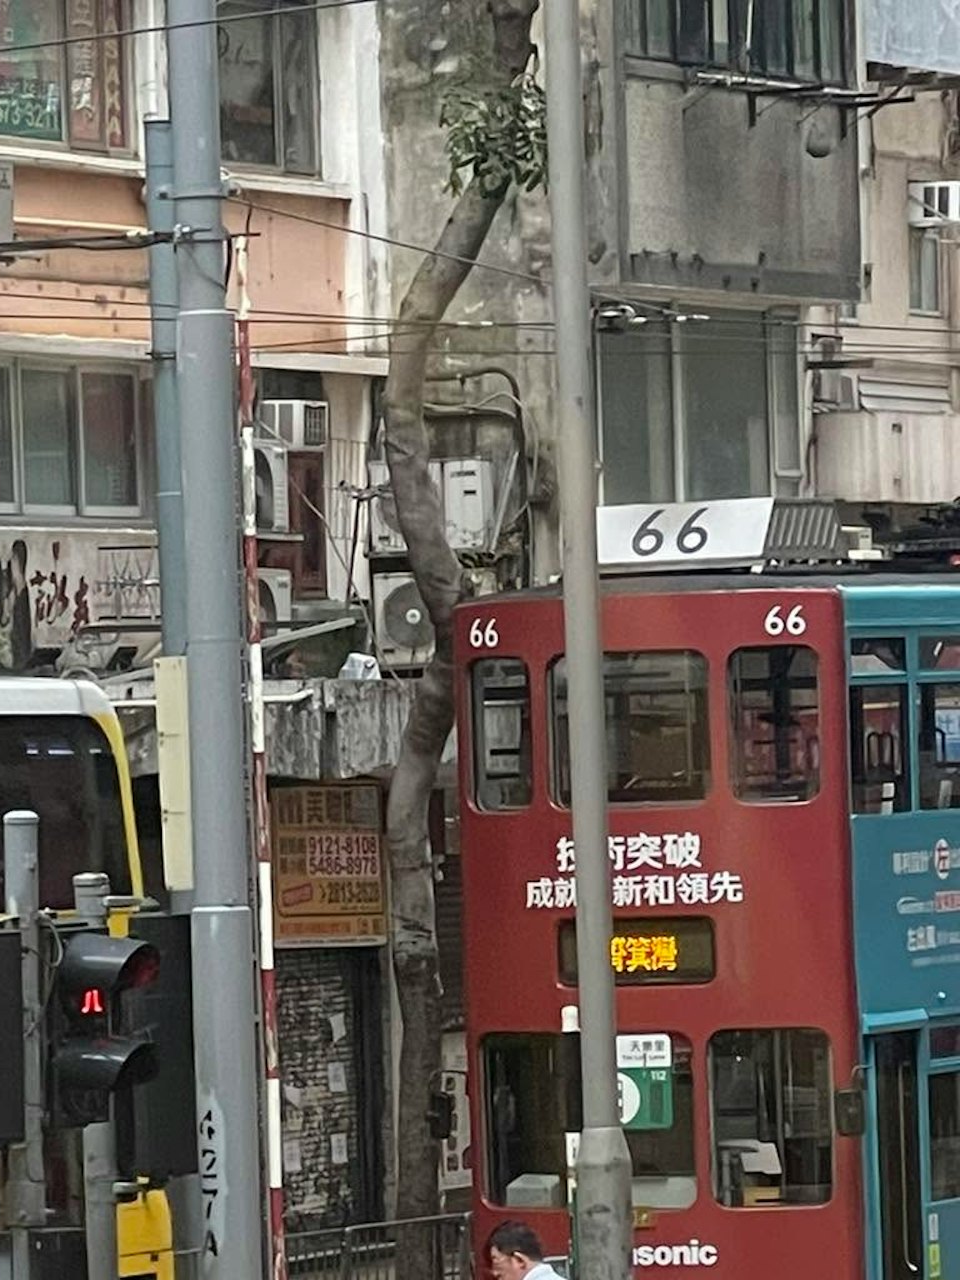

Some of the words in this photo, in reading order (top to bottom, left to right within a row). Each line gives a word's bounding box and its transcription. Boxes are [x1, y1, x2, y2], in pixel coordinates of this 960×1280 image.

[632, 507, 709, 556] 66
[469, 618, 499, 648] 66
[764, 605, 807, 635] 66
[526, 871, 744, 908] 成就新和領先
[632, 1239, 718, 1266] sonic
